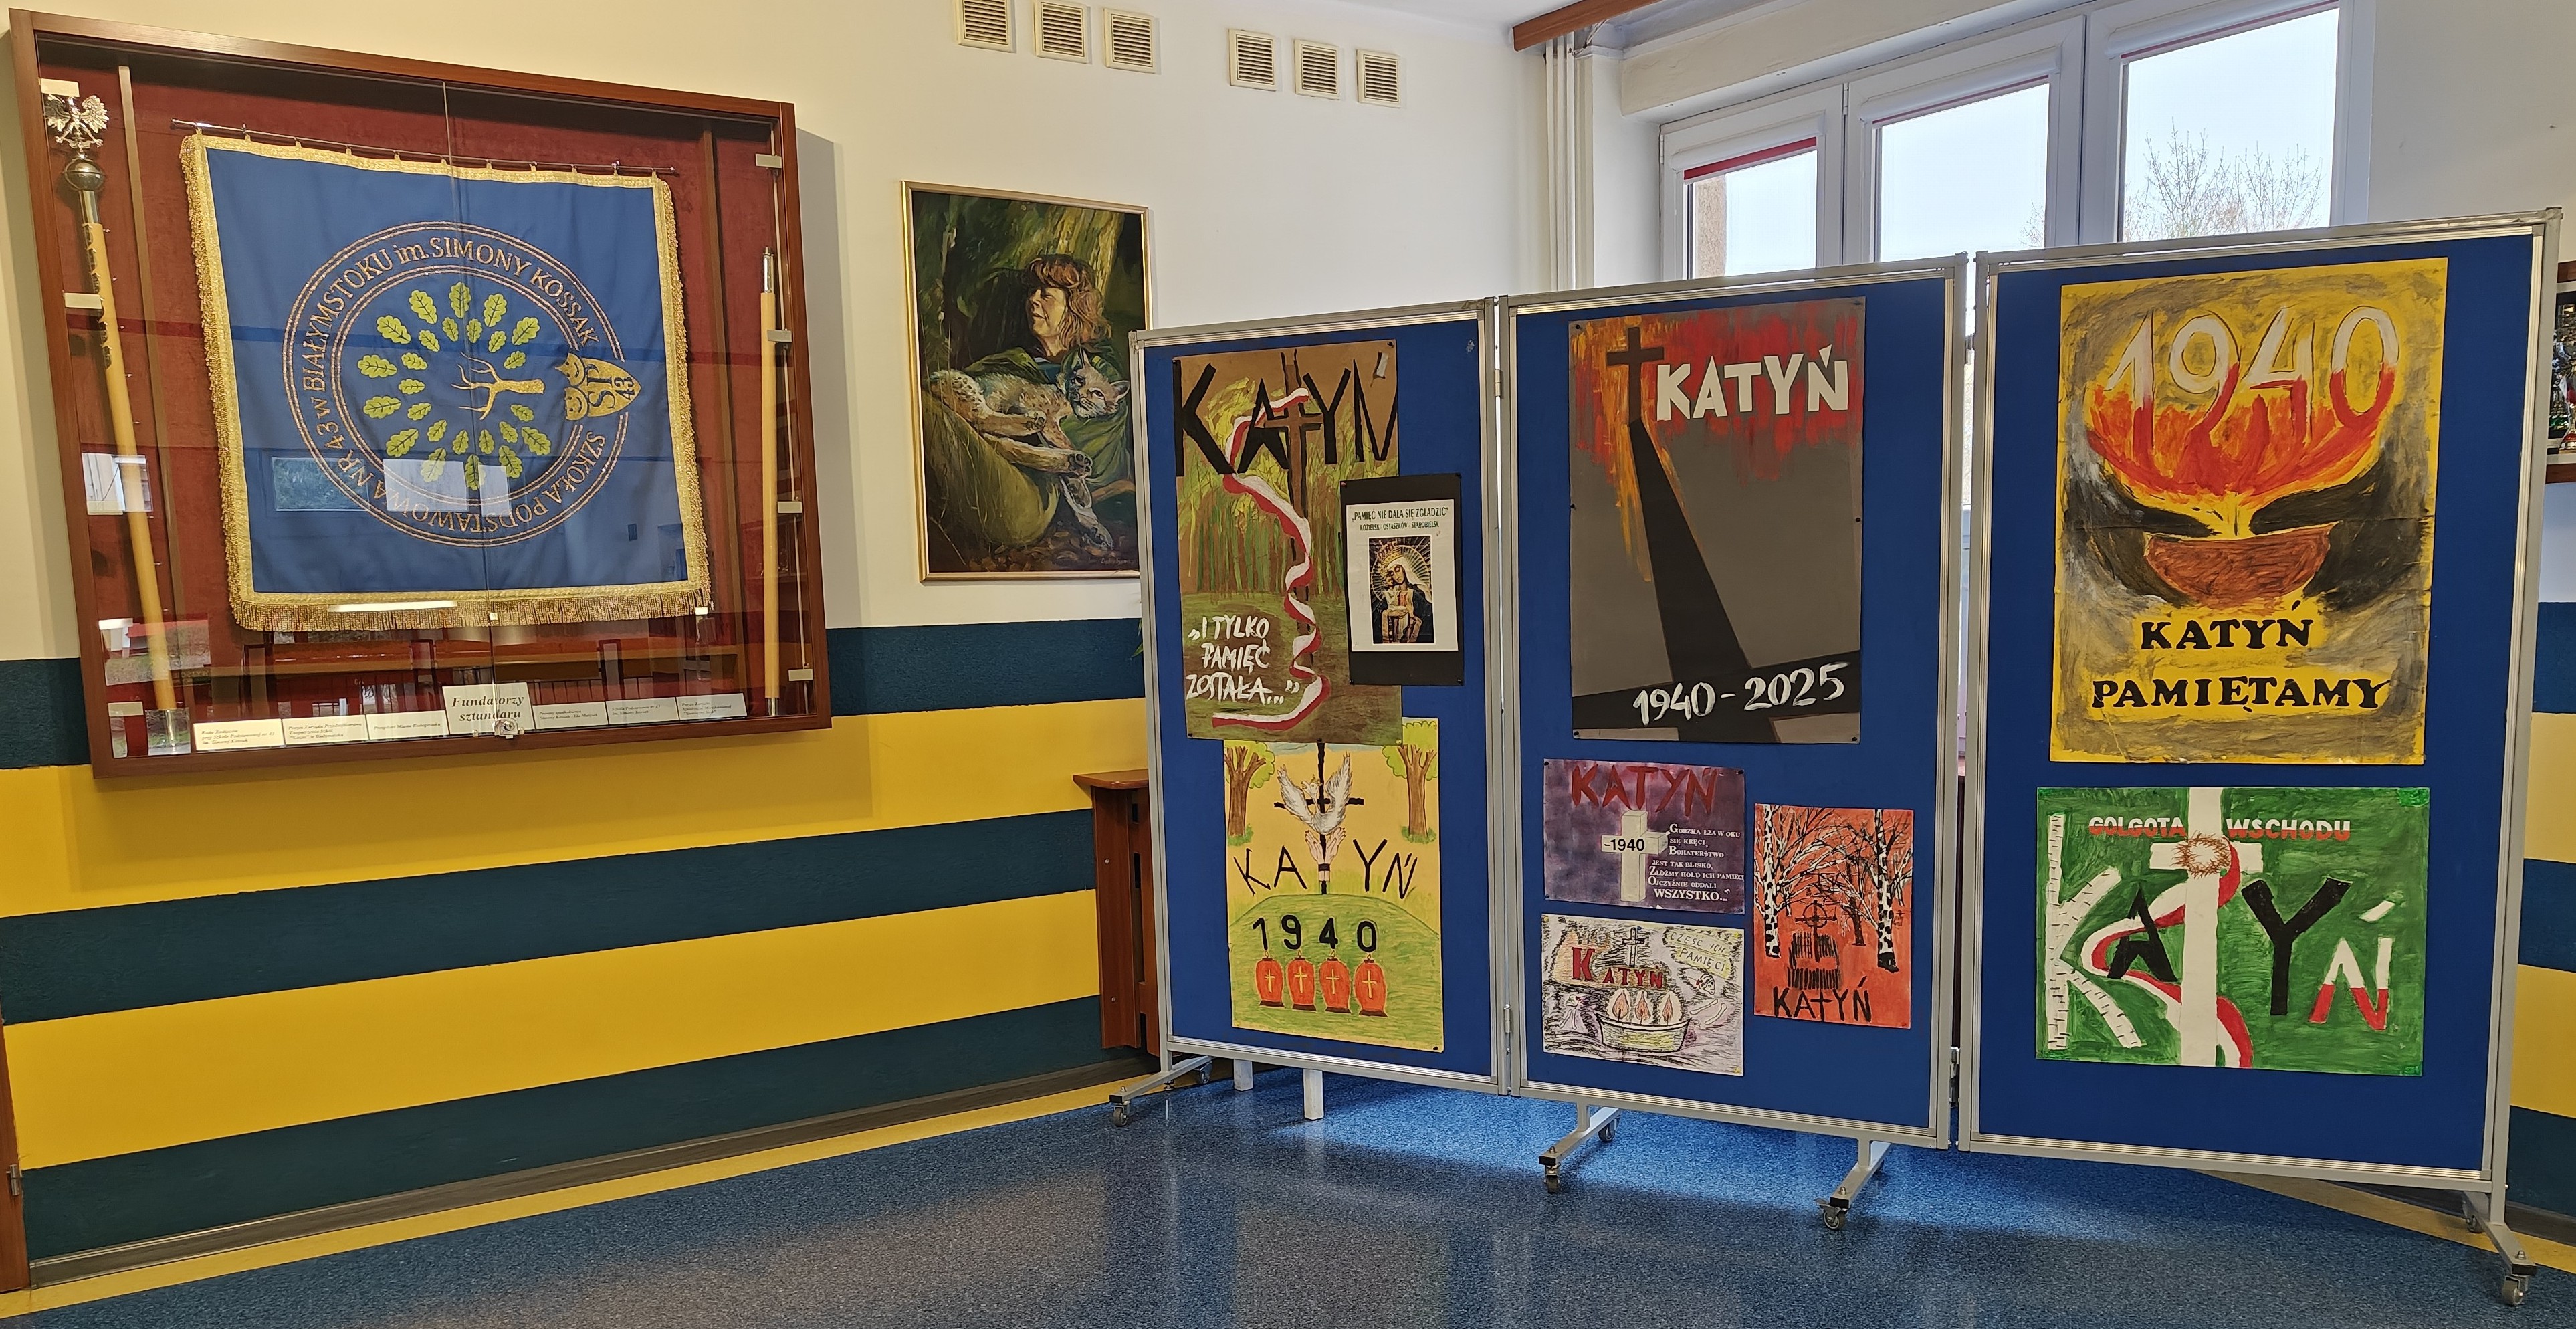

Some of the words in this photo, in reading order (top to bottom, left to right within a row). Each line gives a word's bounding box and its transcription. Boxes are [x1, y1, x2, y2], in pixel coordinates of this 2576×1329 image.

[430, 237, 532, 277] SIMONY
[302, 248, 393, 392] BIAŁYMSTOKU
[529, 266, 599, 346] KOSSAK
[584, 363, 615, 409] SP
[614, 377, 635, 401] 43
[1656, 344, 1848, 421] KATYŃ
[2103, 305, 2399, 448] 1940
[316, 421, 345, 449] 43
[337, 449, 374, 486] NR
[542, 430, 605, 504] SZKOŁA
[374, 479, 548, 533] PODSTAWOWA
[1378, 510, 1387, 519] NIE
[1405, 508, 1414, 520] SIĘ
[1212, 614, 1270, 640] TYLKO
[2140, 599, 2314, 651] KATYŃ
[1201, 639, 1271, 675] PAMIĘĆ
[1632, 681, 1715, 726] 1940
[1743, 661, 1850, 711] 2025
[2092, 676, 2391, 712] PAMIĘTAMY
[1572, 764, 1718, 817] KATYŃ
[1670, 838, 1681, 846] SIĘ
[2088, 816, 2187, 838] GOLGOTA
[2226, 817, 2351, 841] WSCHODU
[1669, 845, 1725, 858] BOHATERSTWO
[1252, 914, 1378, 953] 1940
[1709, 943, 1726, 954] ICH
[1773, 975, 1872, 1022] KATYŃ
